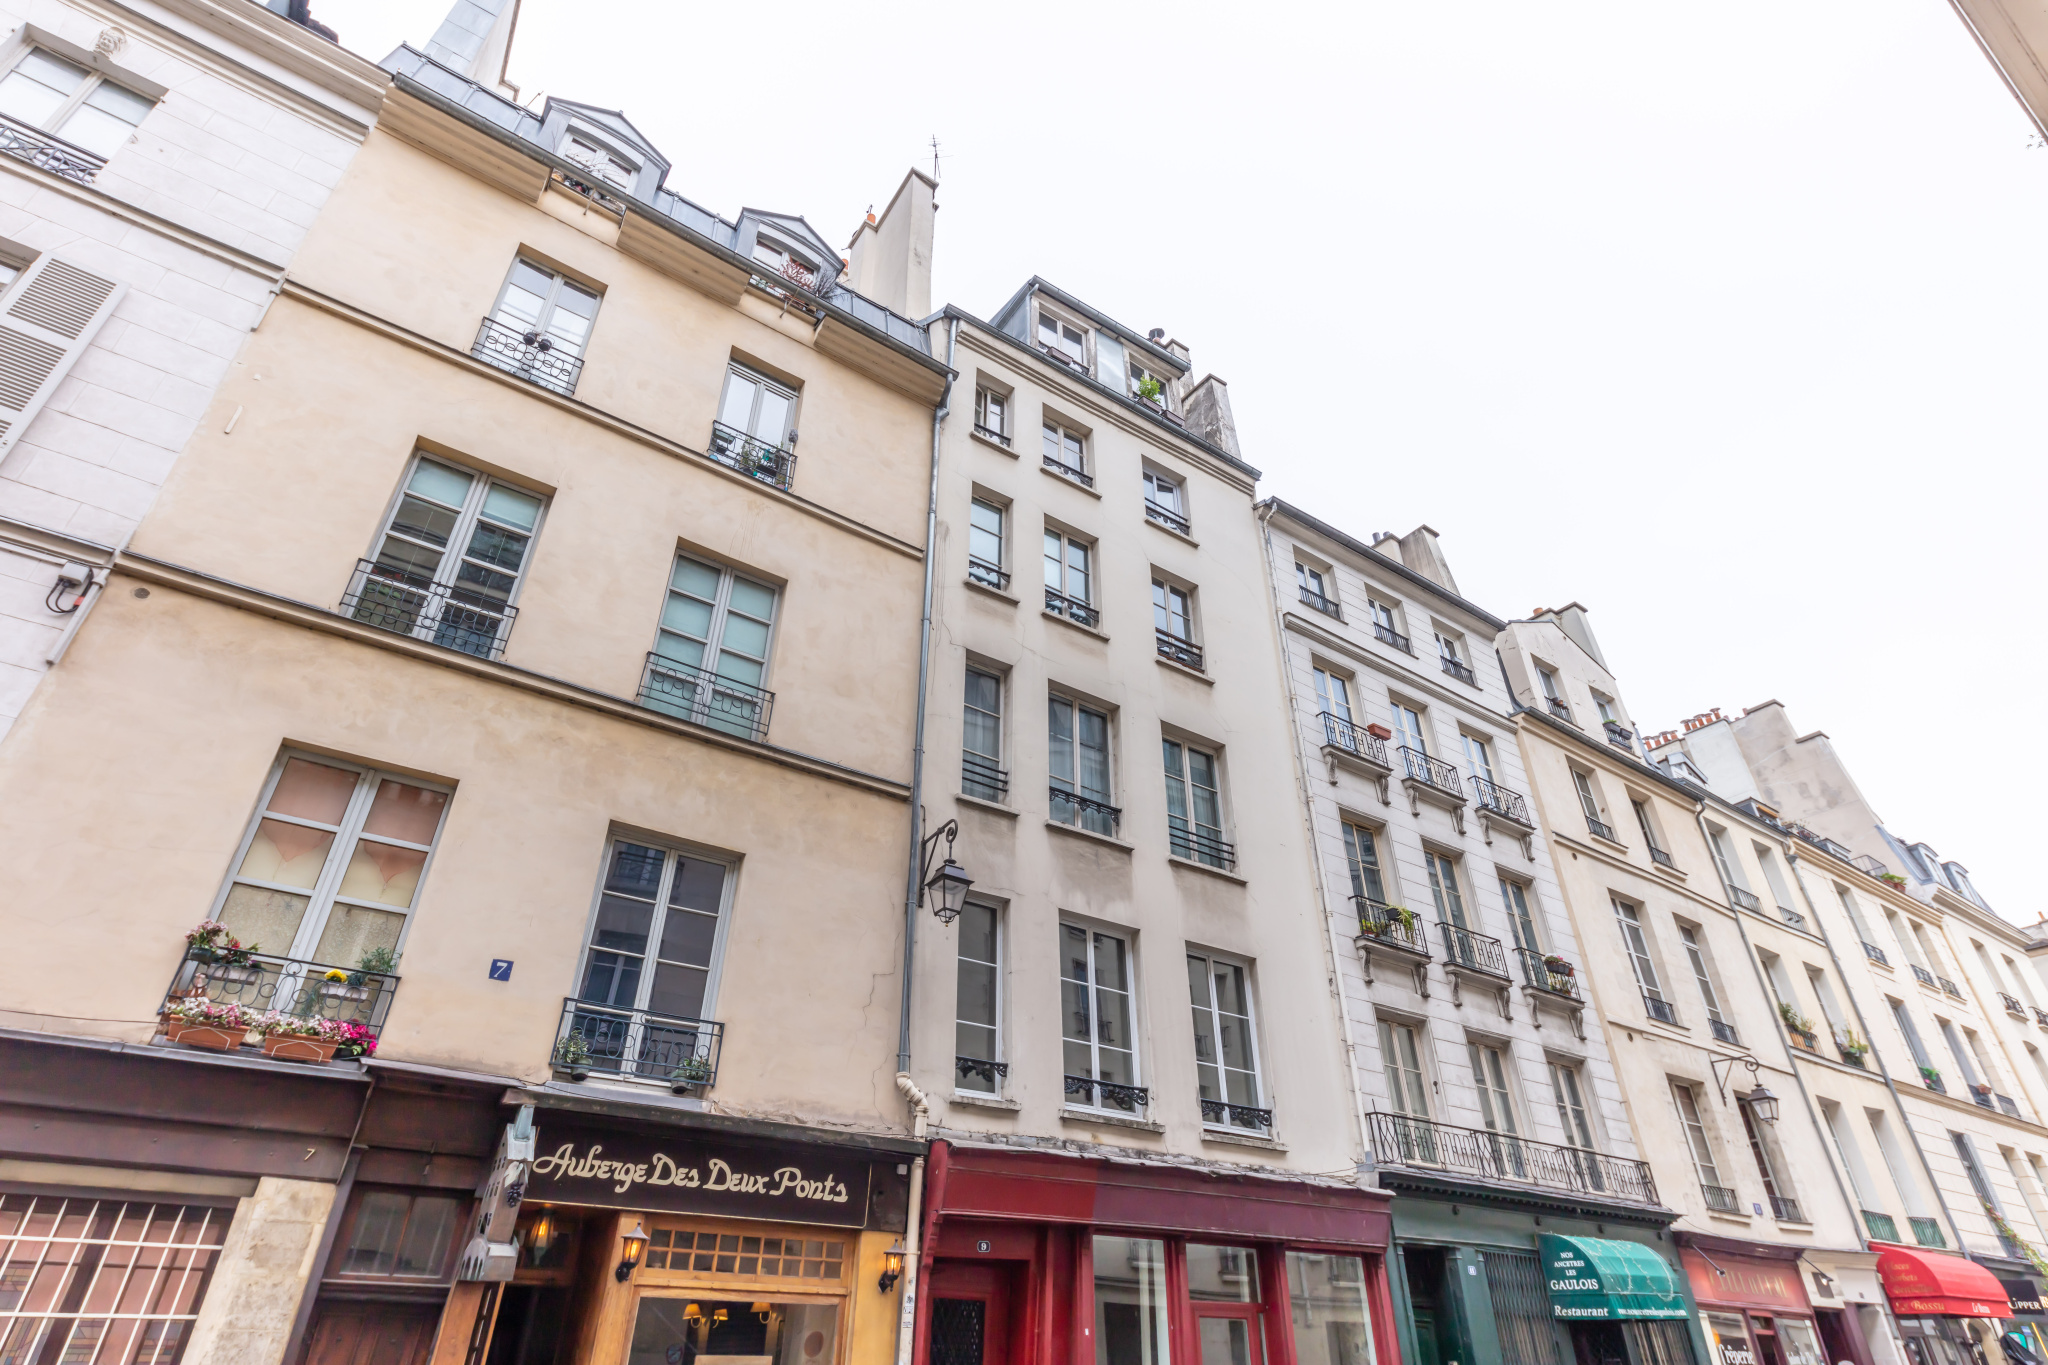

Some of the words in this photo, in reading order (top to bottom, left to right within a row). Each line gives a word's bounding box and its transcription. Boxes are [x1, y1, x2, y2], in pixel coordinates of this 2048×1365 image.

[494, 962, 508, 977] 7
[304, 1148, 315, 1160] 7
[532, 1144, 647, 1193] Auberge
[647, 1153, 700, 1187] Des
[703, 1158, 770, 1194] Deux
[769, 1167, 848, 1202] Ponts
[980, 1242, 987, 1251] 9
[1550, 1278, 1599, 1290] GAULOIS
[1553, 1305, 1609, 1316] Restaurant
